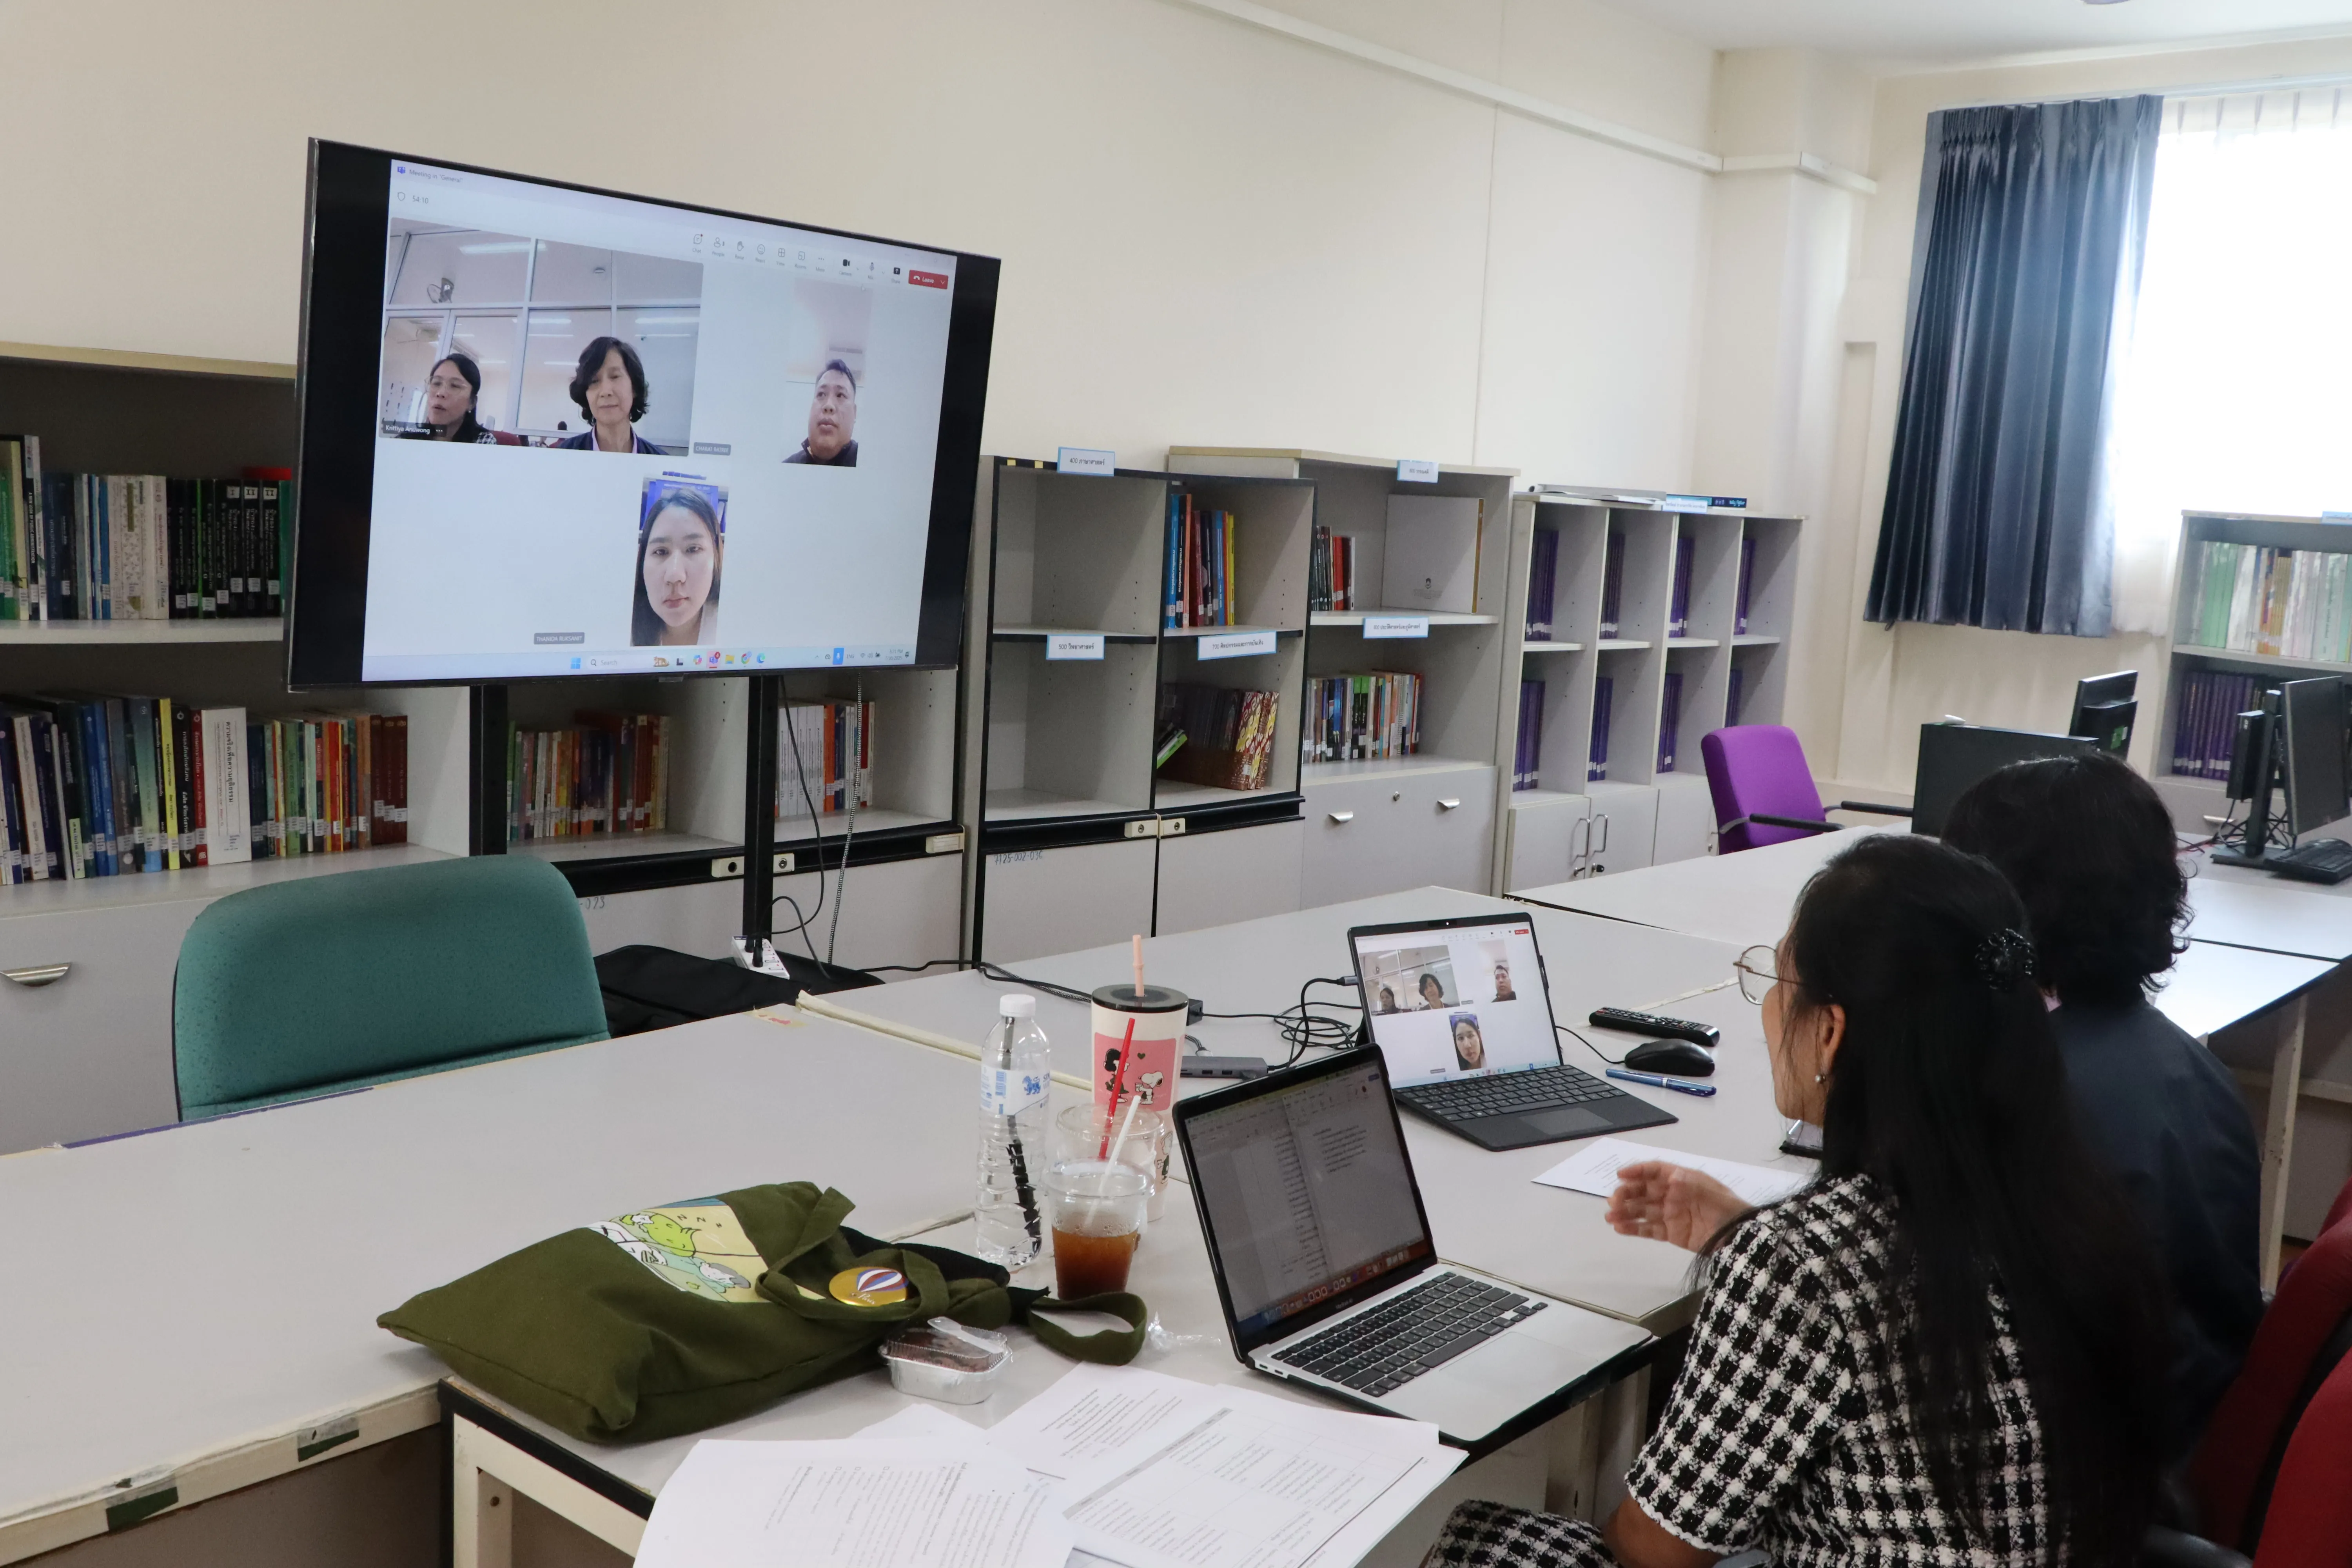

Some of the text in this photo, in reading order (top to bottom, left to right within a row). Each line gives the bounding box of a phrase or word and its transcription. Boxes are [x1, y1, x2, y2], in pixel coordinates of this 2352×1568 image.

[409, 169, 431, 179] Meeting
[412, 195, 429, 204] 54:10
[858, 1293, 875, 1305] Paris
